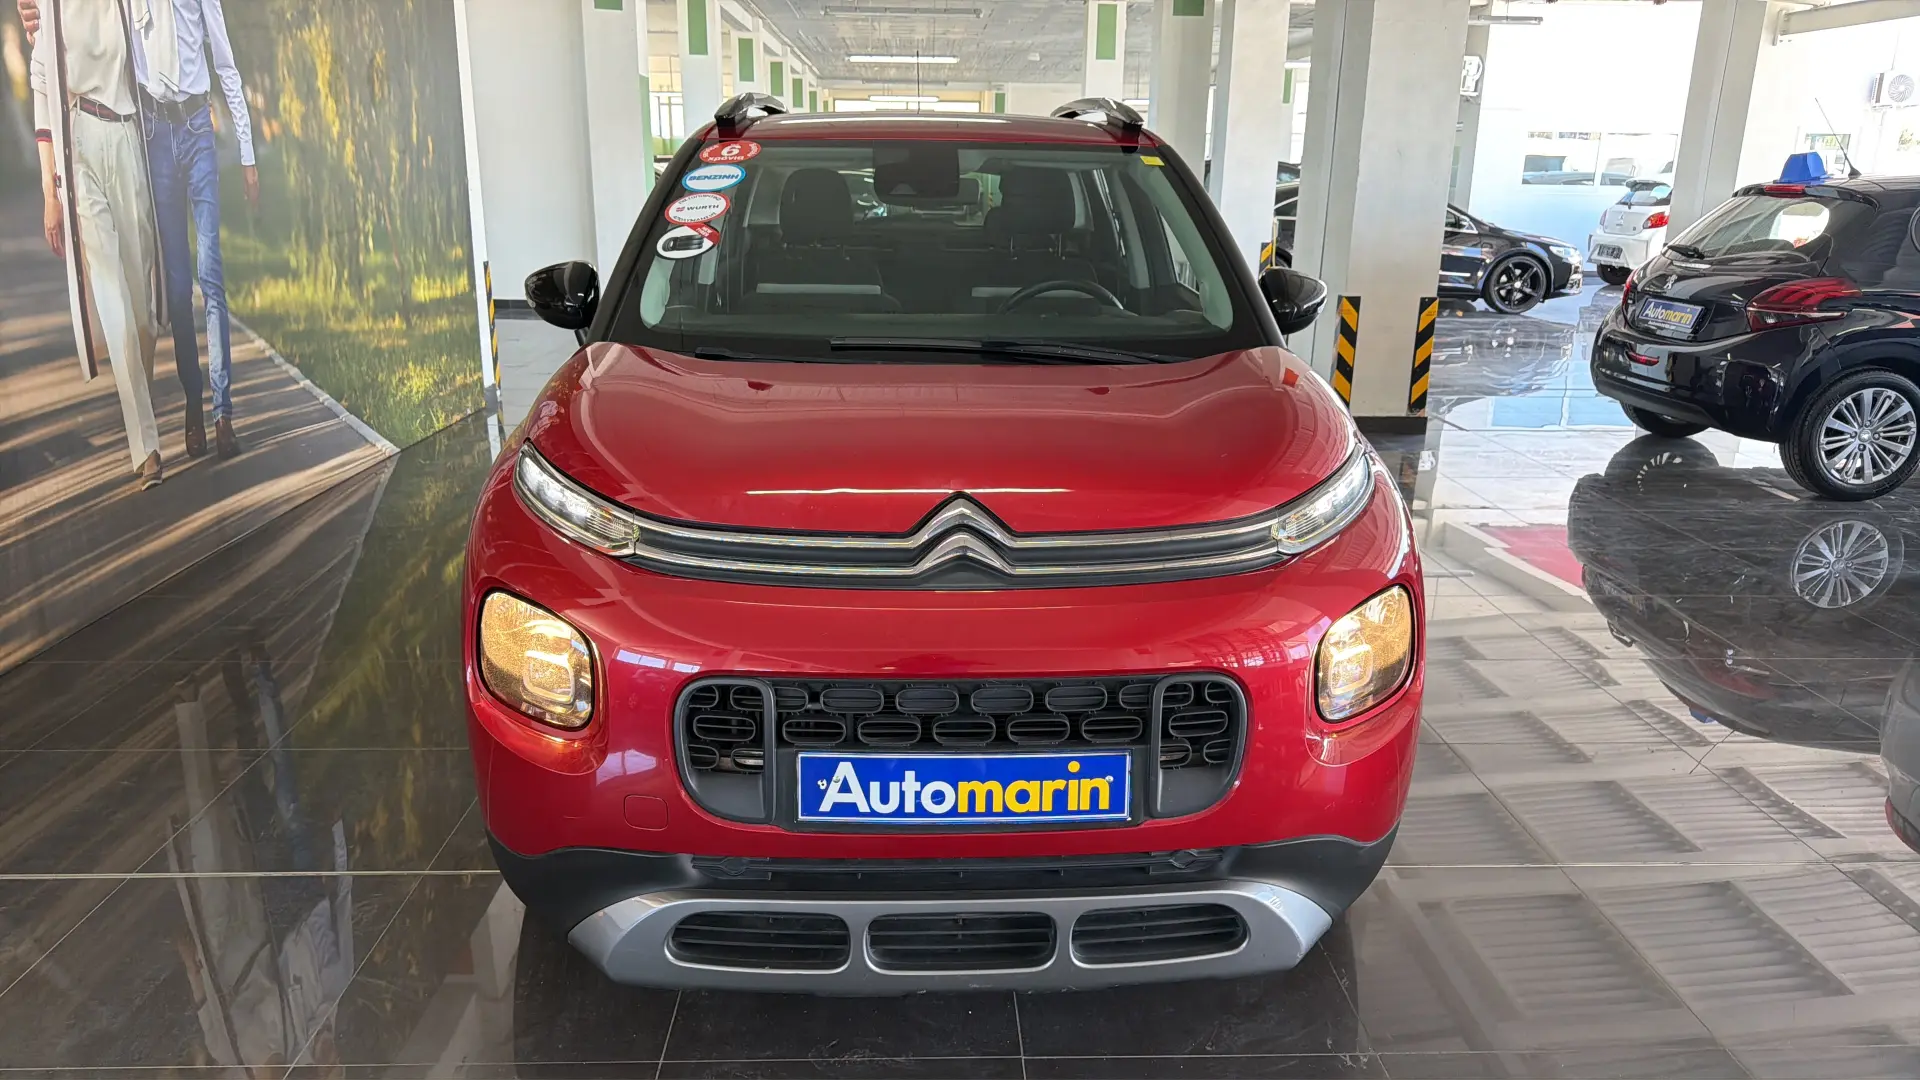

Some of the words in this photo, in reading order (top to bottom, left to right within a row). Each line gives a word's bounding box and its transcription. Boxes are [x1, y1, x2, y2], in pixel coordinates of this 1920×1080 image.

[721, 145, 741, 156] 6
[1643, 302, 1693, 324] Automarin
[818, 760, 1111, 814] Automarin
